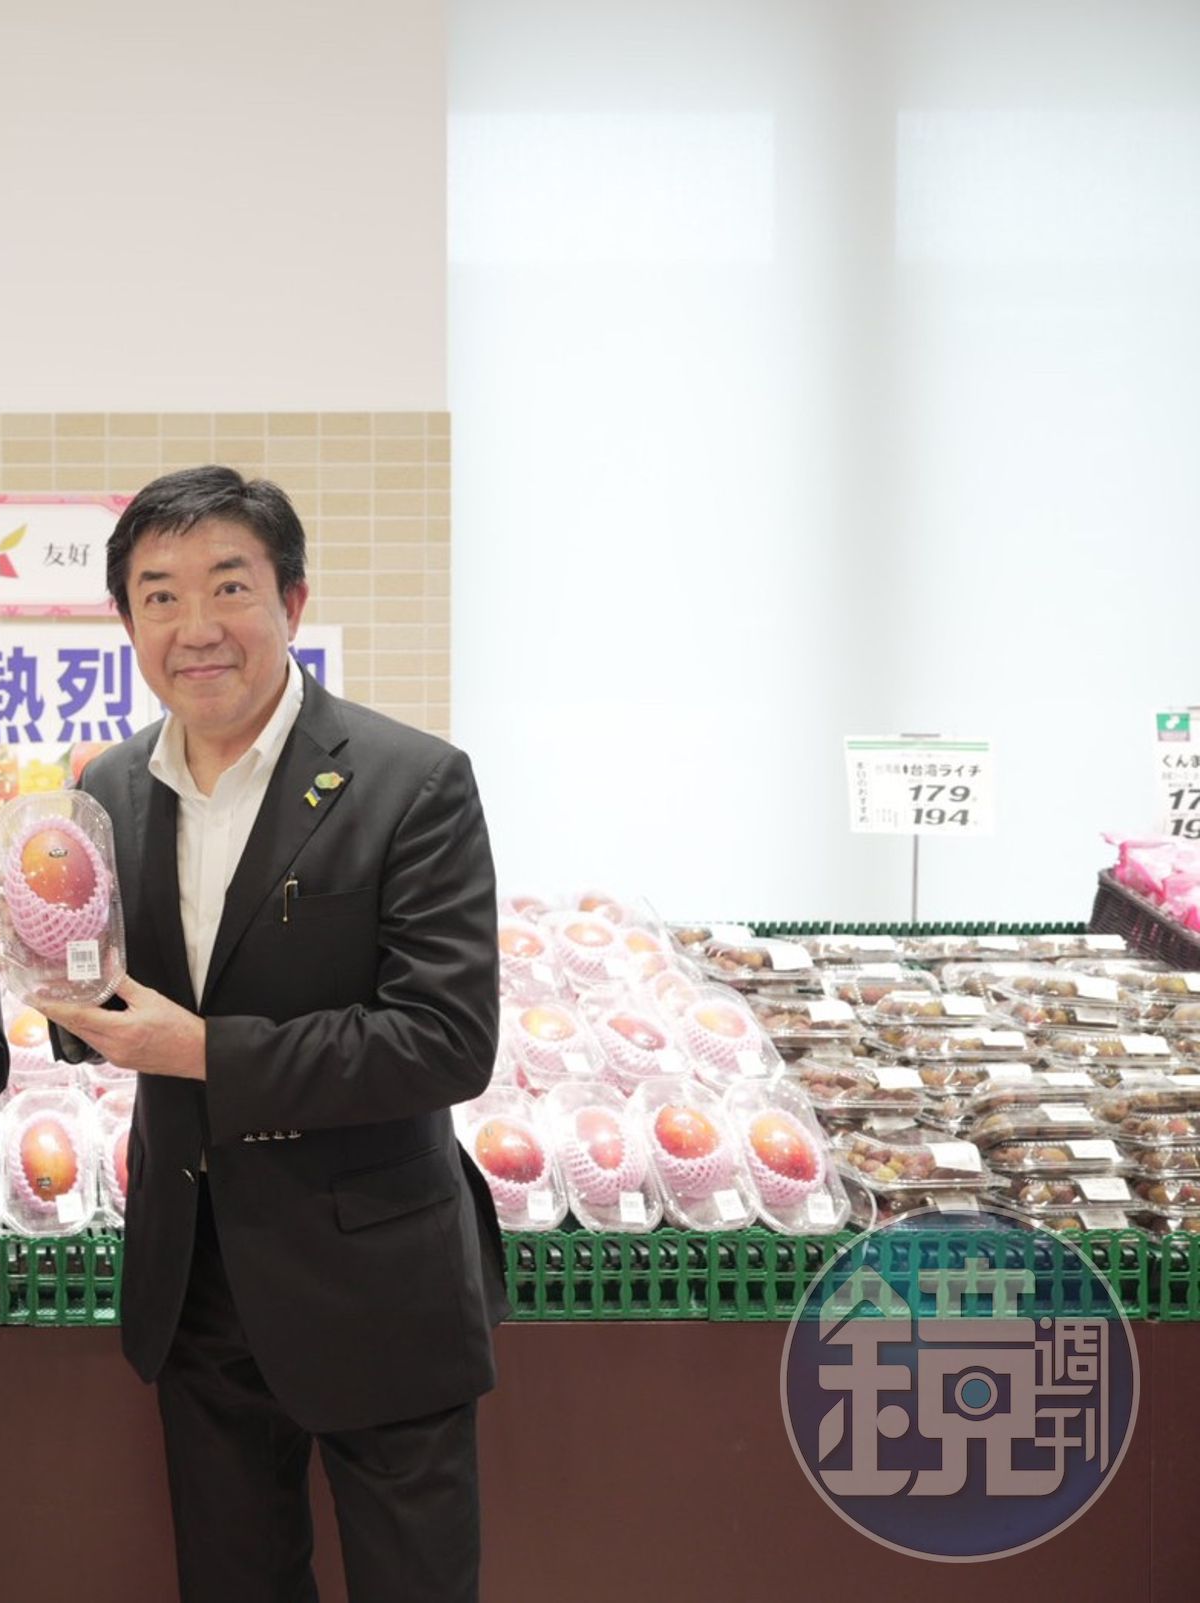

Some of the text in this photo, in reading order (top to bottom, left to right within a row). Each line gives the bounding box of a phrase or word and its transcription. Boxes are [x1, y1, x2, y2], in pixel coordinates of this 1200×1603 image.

[43, 543, 90, 567] 友好
[910, 763, 982, 778] 台湾ライチ
[908, 784, 971, 803] 179
[911, 807, 970, 826] 194
